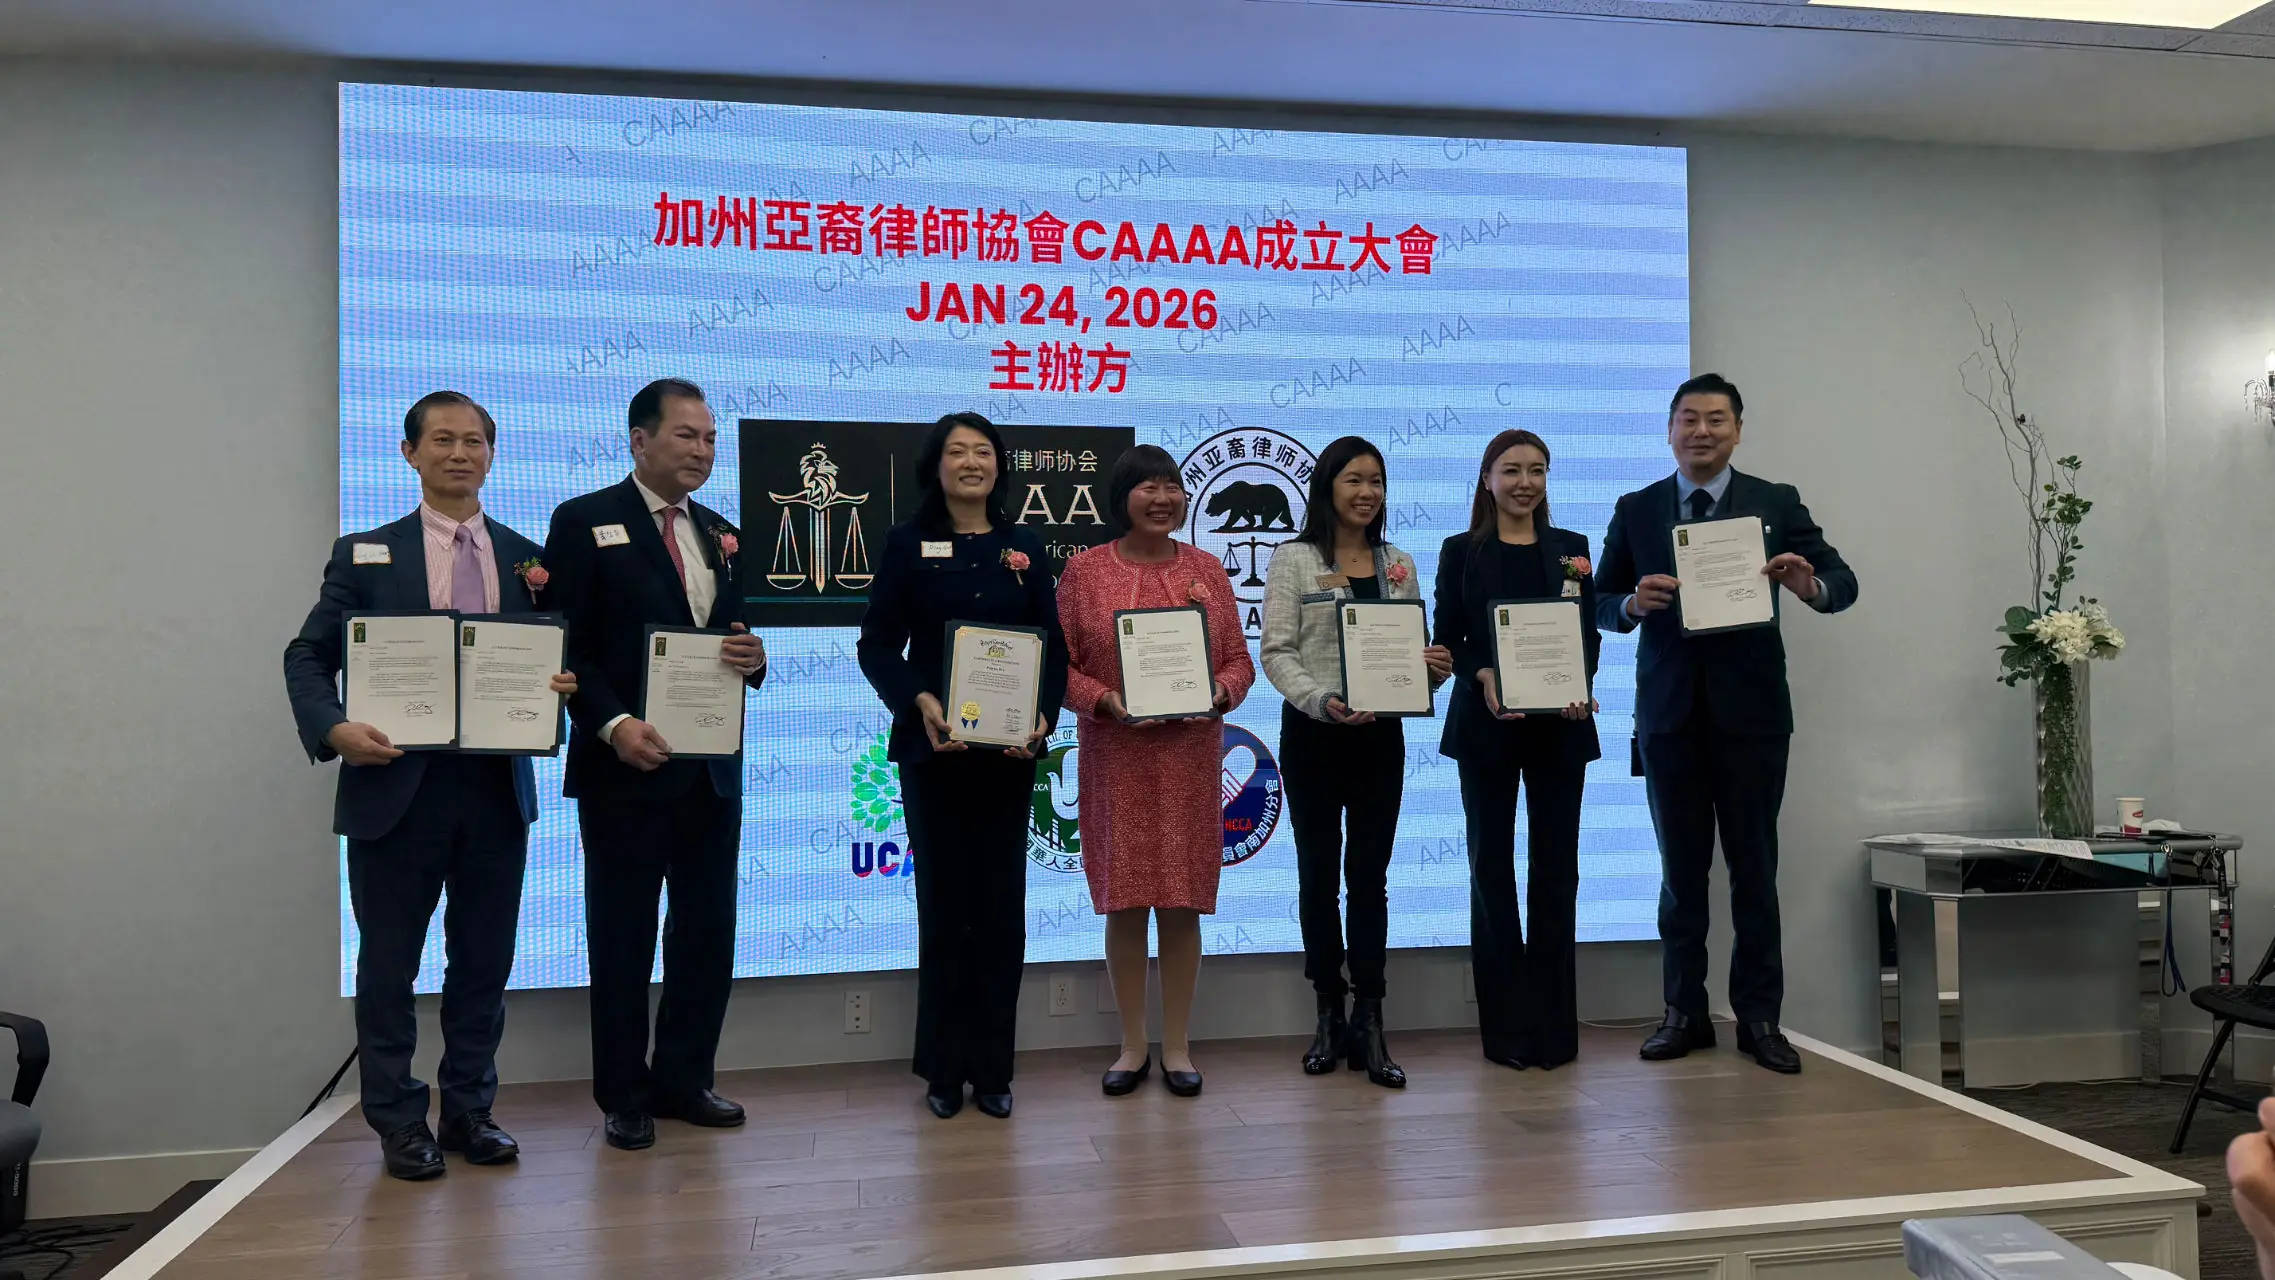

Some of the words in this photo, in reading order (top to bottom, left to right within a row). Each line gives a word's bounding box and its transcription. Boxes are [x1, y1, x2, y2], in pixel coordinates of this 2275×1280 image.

[849, 139, 932, 188] AAAA
[1075, 150, 1176, 204] CAAAA
[1334, 159, 1409, 205] AAAA
[653, 191, 1439, 276] 加州亞裔律師協會CAAAA成立大會
[688, 287, 774, 339] AAAA
[905, 280, 1006, 324] JAN
[1019, 282, 1092, 335] 24,
[1104, 285, 1218, 331] 2026
[828, 336, 912, 387] AAAA
[1401, 313, 1477, 363] AAAA
[988, 339, 1132, 394] 主辦方
[1269, 356, 1368, 410] CAAAA
[1388, 405, 1463, 451] AAAA
[778, 903, 865, 960] AAAA
